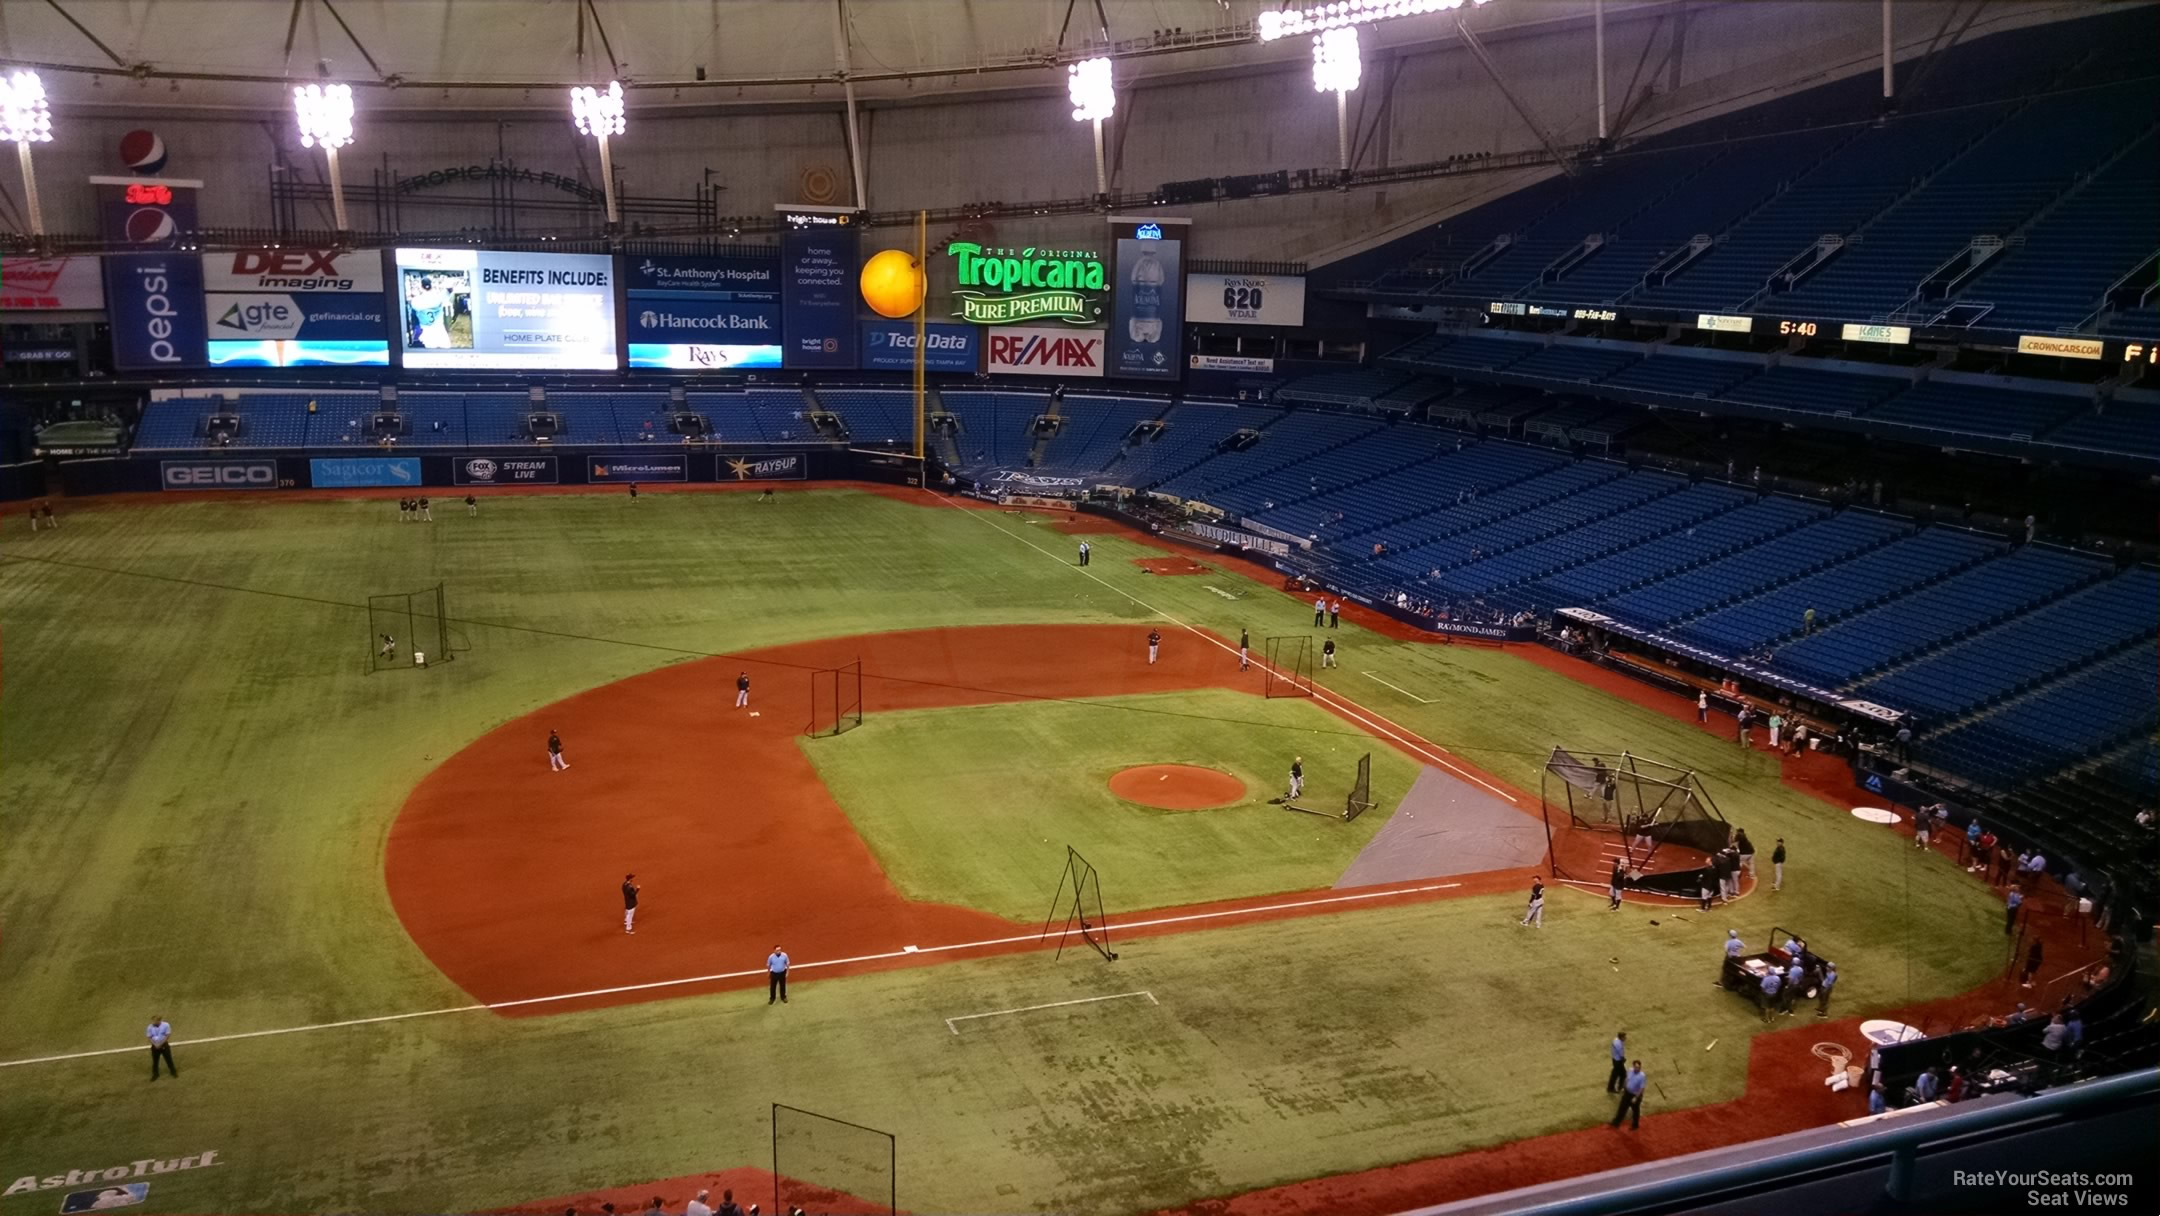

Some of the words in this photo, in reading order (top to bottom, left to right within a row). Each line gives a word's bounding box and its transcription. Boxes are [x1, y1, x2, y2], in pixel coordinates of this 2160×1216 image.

[807, 247, 832, 256] home
[986, 248, 1015, 256] THE
[1040, 249, 1098, 258] ORIGINAL
[231, 249, 344, 276] DEX
[948, 242, 1104, 292] Tropicana
[483, 269, 544, 285] BENEFITS
[548, 270, 608, 286] INCLUDE:
[657, 267, 671, 278] St.
[673, 268, 725, 281] Anthony's
[727, 270, 770, 282] Hospital
[795, 265, 828, 277] keeping
[829, 269, 844, 277] you
[258, 276, 354, 290] imaging
[797, 278, 843, 286] connected.
[1223, 287, 1262, 310] 620
[137, 267, 182, 362] pepsi
[246, 301, 289, 326] gte
[964, 300, 1006, 319] PURE
[1010, 296, 1083, 317] PREMIUM
[1228, 310, 1257, 318] WDAE
[309, 312, 381, 323] gtefinancial.org
[660, 313, 727, 328] Hancock
[729, 315, 769, 329] Bank
[1779, 320, 1817, 337] 5:40
[504, 334, 532, 343] HOME
[534, 334, 562, 343] PLATE
[802, 338, 821, 346] bright
[927, 334, 967, 349] Data
[990, 335, 1097, 367] RE/MAX
[2027, 341, 2100, 355] CROWNCARS.COM
[321, 462, 384, 479] Sagicor
[503, 462, 546, 470] STREAM
[166, 466, 273, 485] GEICO
[514, 471, 536, 479] LIVE
[280, 479, 294, 487] 370
[1437, 622, 1479, 634] RAYMOND
[1479, 627, 1507, 637] JAMES
[1604, 620, 1646, 634] FIELD
[1647, 634, 1730, 662] TROPICANA
[1733, 662, 1755, 671] TO
[1757, 670, 1845, 700] WELCOME
[2, 1150, 219, 1196] AstroTurf
